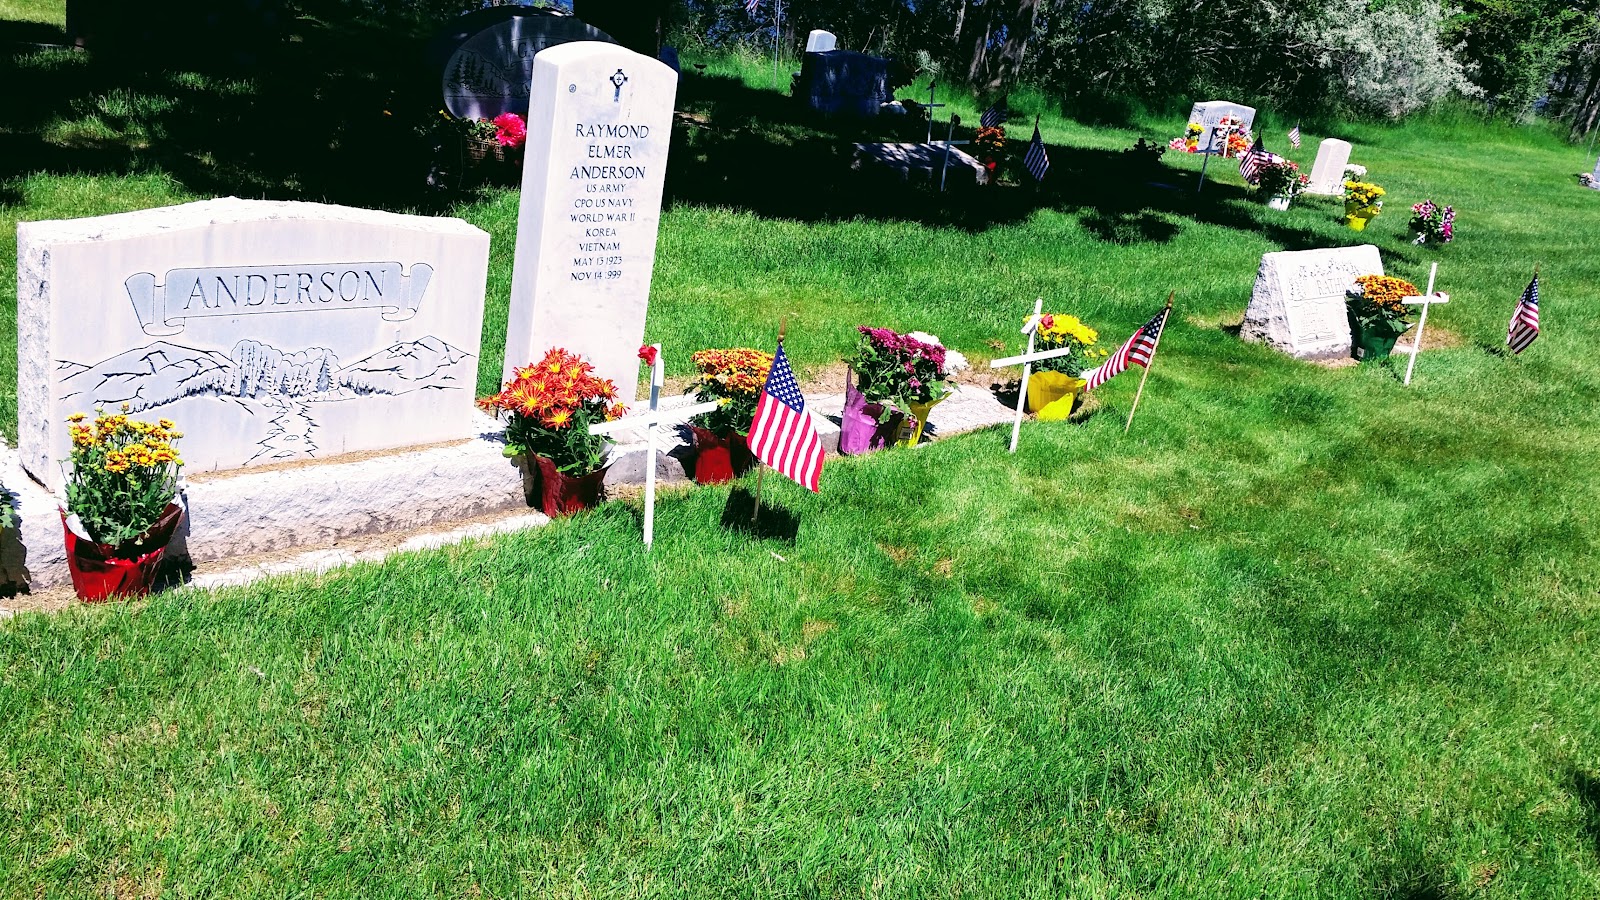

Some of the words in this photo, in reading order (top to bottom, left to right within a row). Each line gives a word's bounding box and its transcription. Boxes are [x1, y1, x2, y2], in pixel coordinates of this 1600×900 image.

[576, 123, 649, 139] RAYMOND
[588, 145, 632, 159] ELMER
[570, 166, 646, 180] ANDERSON
[586, 184, 597, 193] US
[599, 183, 626, 193] ARMY
[574, 199, 594, 208] CPO
[595, 198, 606, 208] US
[608, 198, 634, 208] NAVY
[570, 213, 604, 223] WORLD
[606, 213, 627, 222] WAR
[585, 228, 617, 237] KOREA
[579, 242, 620, 252] VIETNAM
[573, 257, 595, 267] MAY
[605, 256, 623, 266] 1923
[570, 271, 592, 281] NOV
[594, 271, 603, 280] 14
[183, 269, 387, 310] ANDERSON
